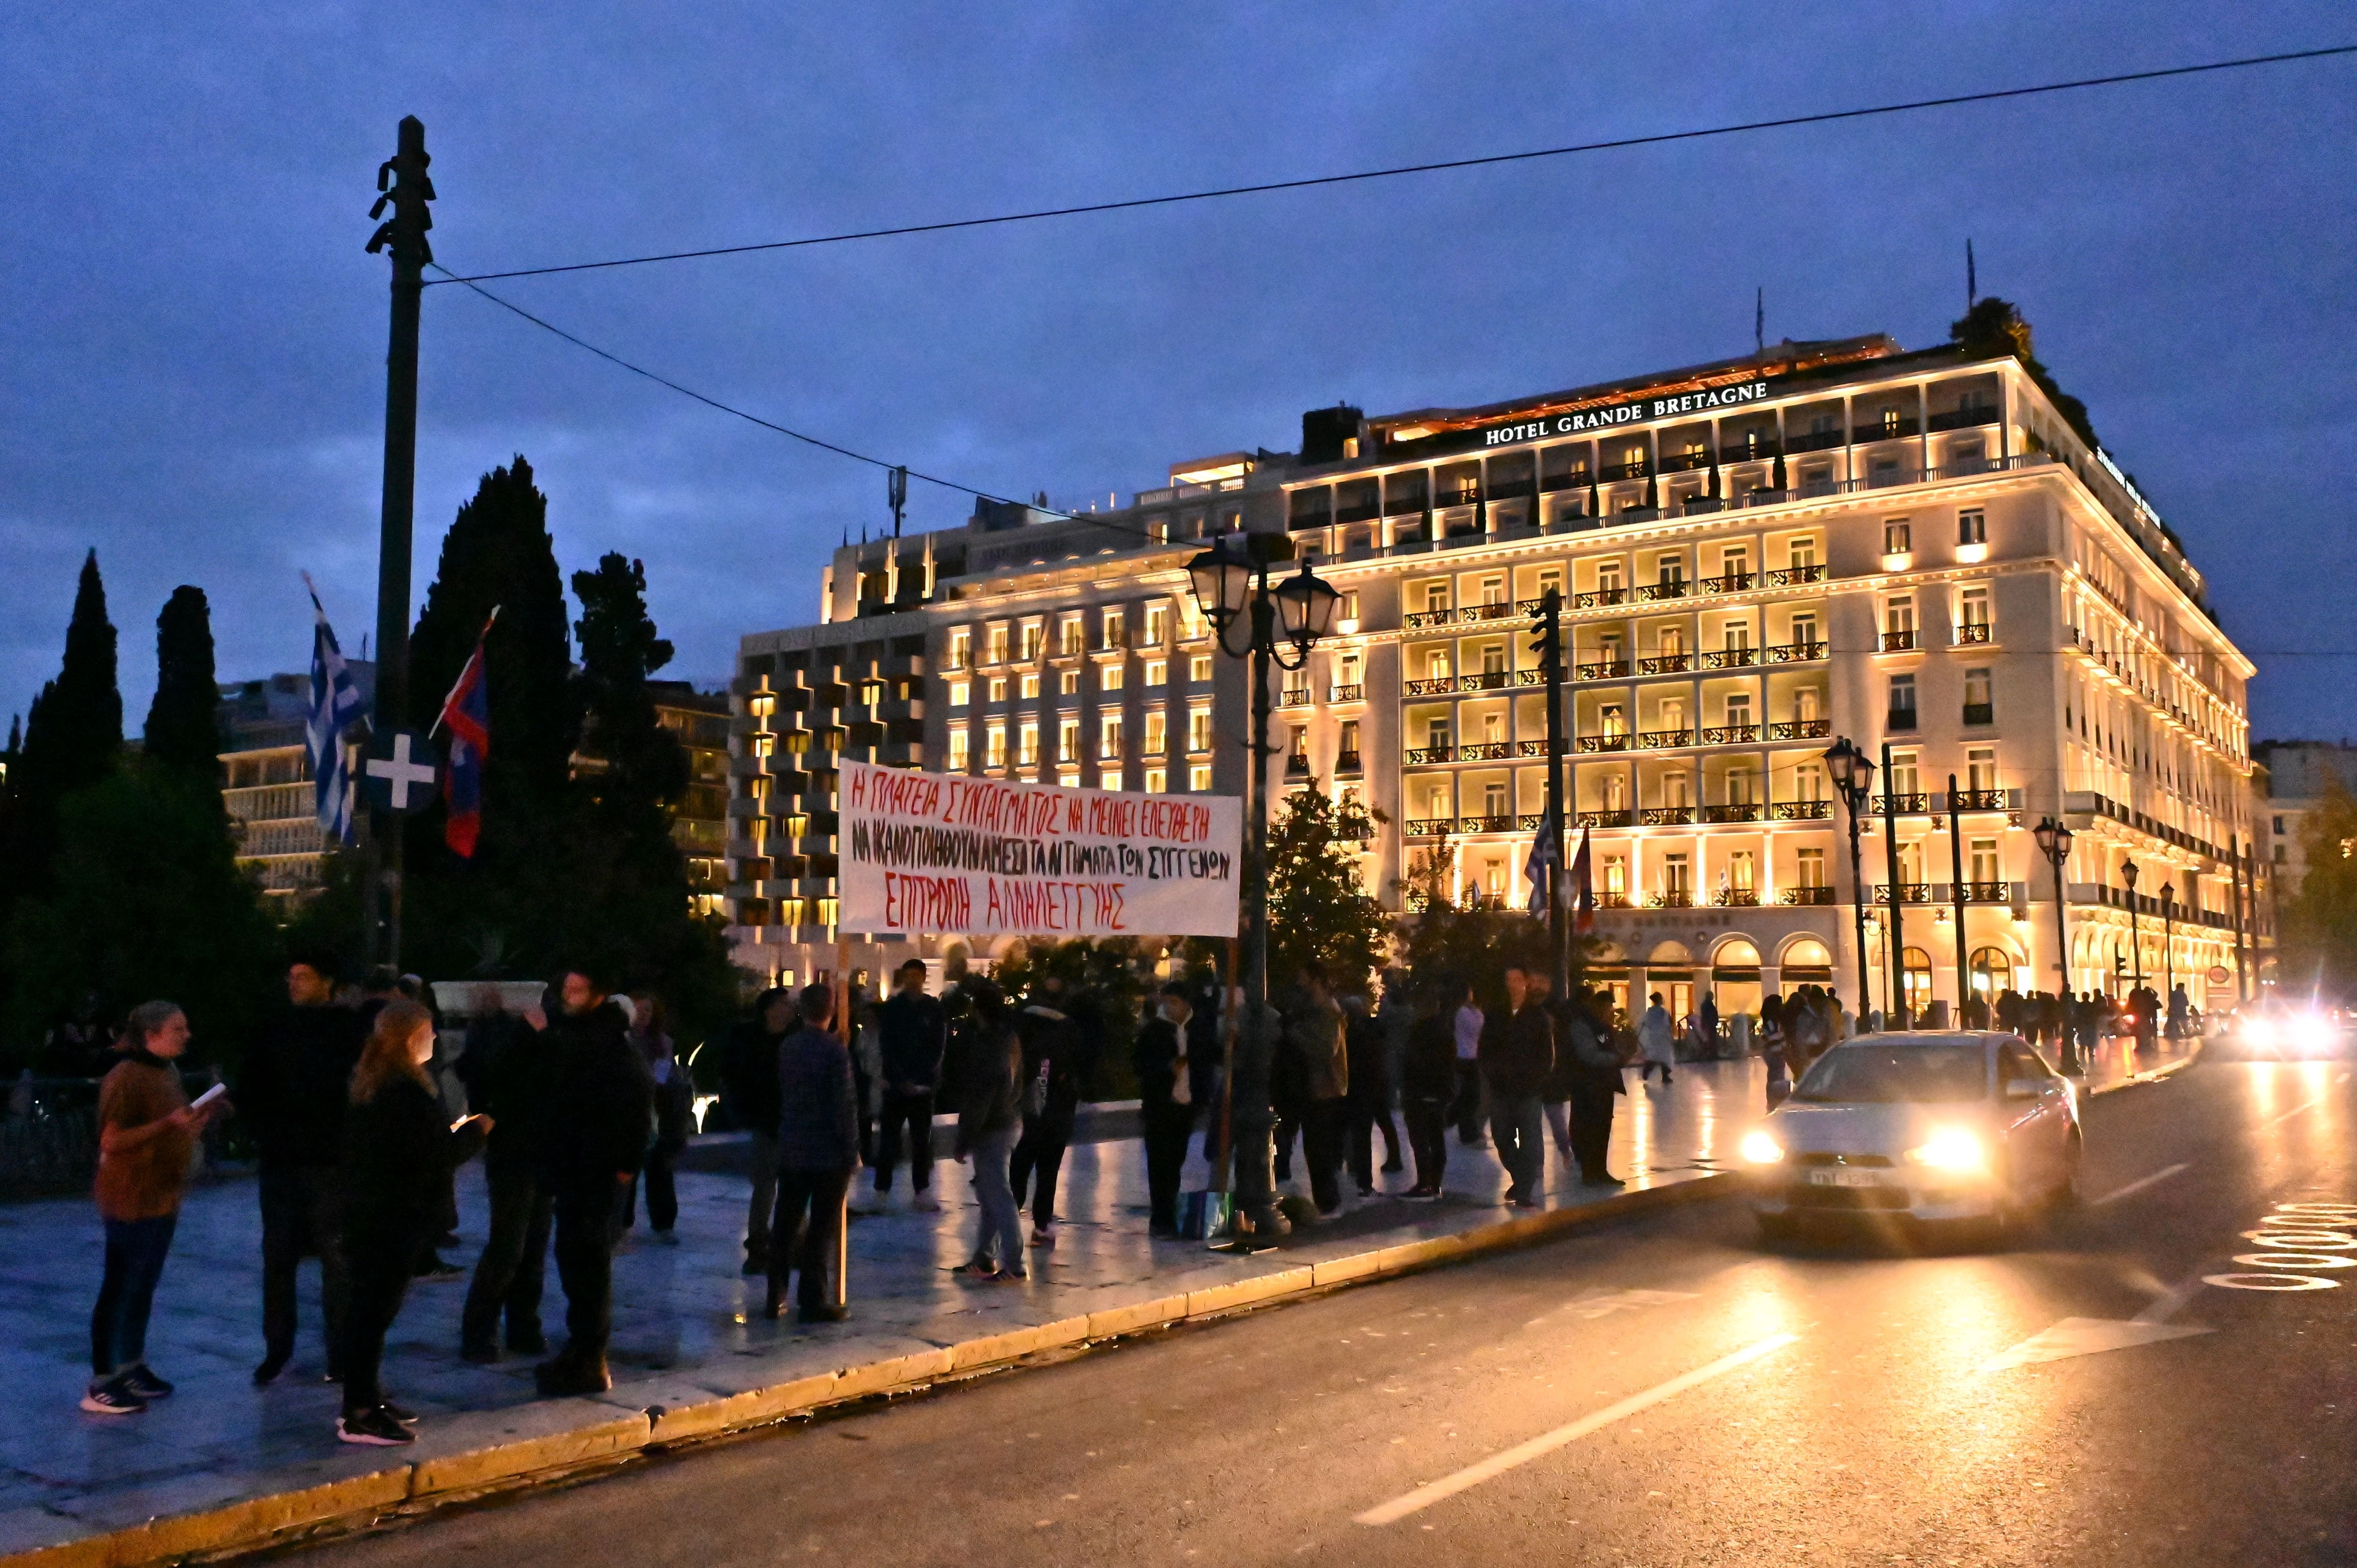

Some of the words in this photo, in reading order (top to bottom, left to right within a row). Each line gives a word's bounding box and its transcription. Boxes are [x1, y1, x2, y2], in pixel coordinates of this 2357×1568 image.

[1486, 421, 1549, 445] HOTEL
[1558, 404, 1642, 433] GRANDE
[1654, 382, 1767, 417] BRETAGNE
[851, 768, 865, 808] Η
[870, 771, 940, 817] ΠΛΑΤΕΙΑ
[943, 780, 1063, 838] ΣΥΝΤΑΓΜΑΤΟΣ
[1067, 797, 1083, 834] ΝΑ
[1088, 796, 1136, 838] ΜΕΙΝΕΙ
[1141, 800, 1210, 843] ΕΛΕΥΘΕΡΗ
[852, 817, 871, 865] ΝΑ
[873, 817, 981, 871] ΙΚΑΝΟΠΟΙΗΘΟΥΝ
[981, 834, 1028, 875] ΑΜΕΣΑ
[1030, 839, 1046, 876] ΤΑ
[885, 871, 971, 931] ΕΠΙΤΡΟΠΗ
[987, 876, 1125, 931] ΑΛΛΗΛΕΓΓΥΗΣ
